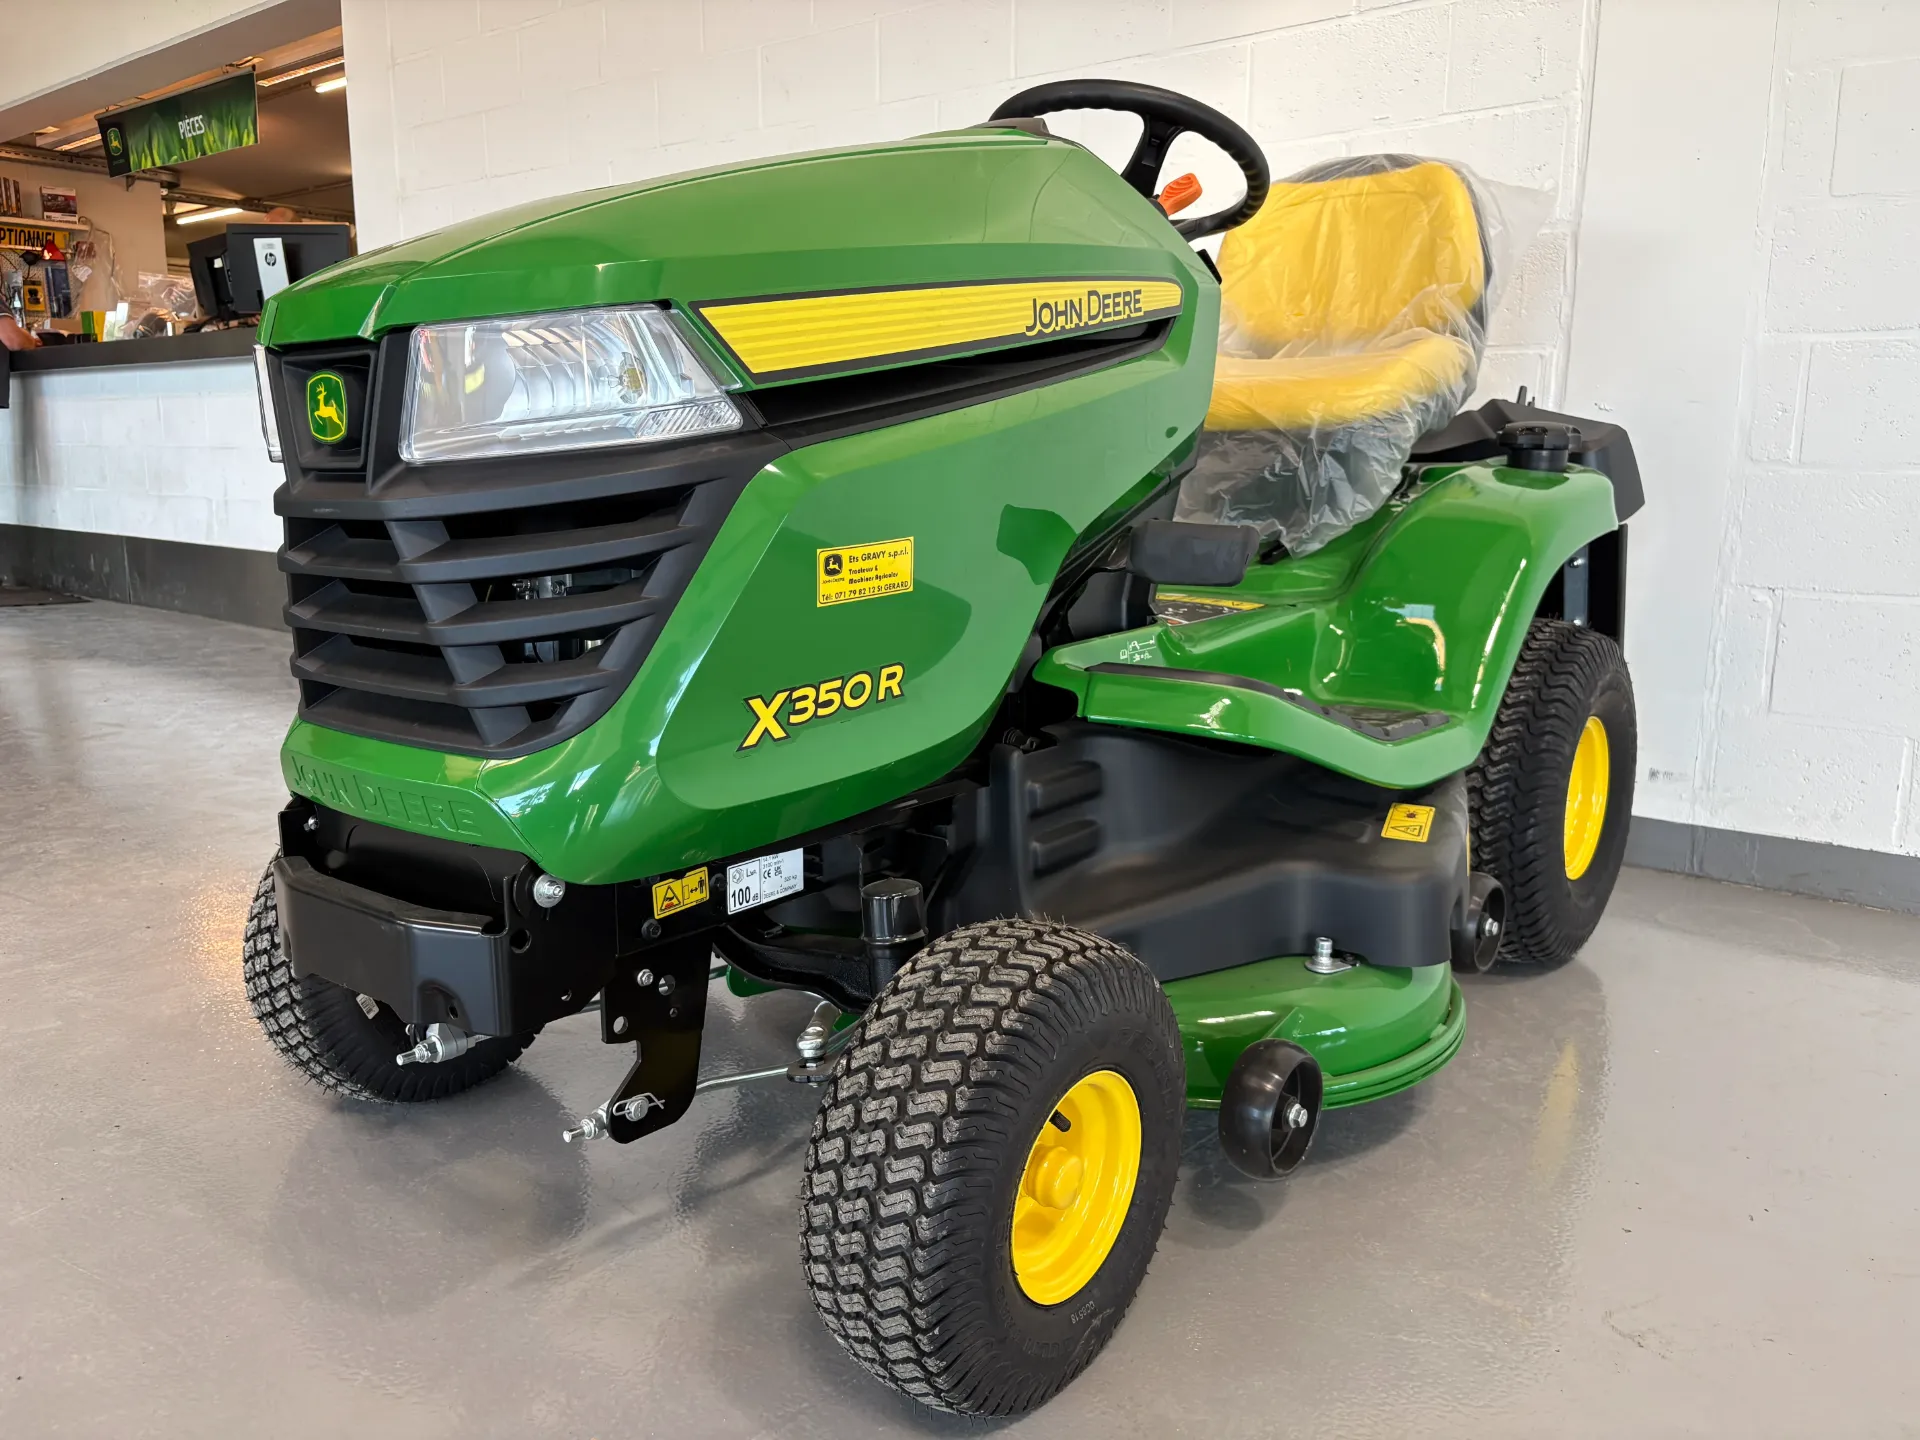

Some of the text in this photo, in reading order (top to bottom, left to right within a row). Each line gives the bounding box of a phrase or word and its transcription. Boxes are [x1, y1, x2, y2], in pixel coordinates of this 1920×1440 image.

[178, 115, 205, 139] PIÈCES
[1025, 289, 1143, 333] JOHN DEERE
[861, 551, 886, 561] GRAVY
[835, 591, 846, 599] 071
[848, 589, 857, 597] 79
[884, 581, 909, 591] GERARD
[291, 756, 482, 837] JOHN DEERE
[731, 886, 751, 908] 100
